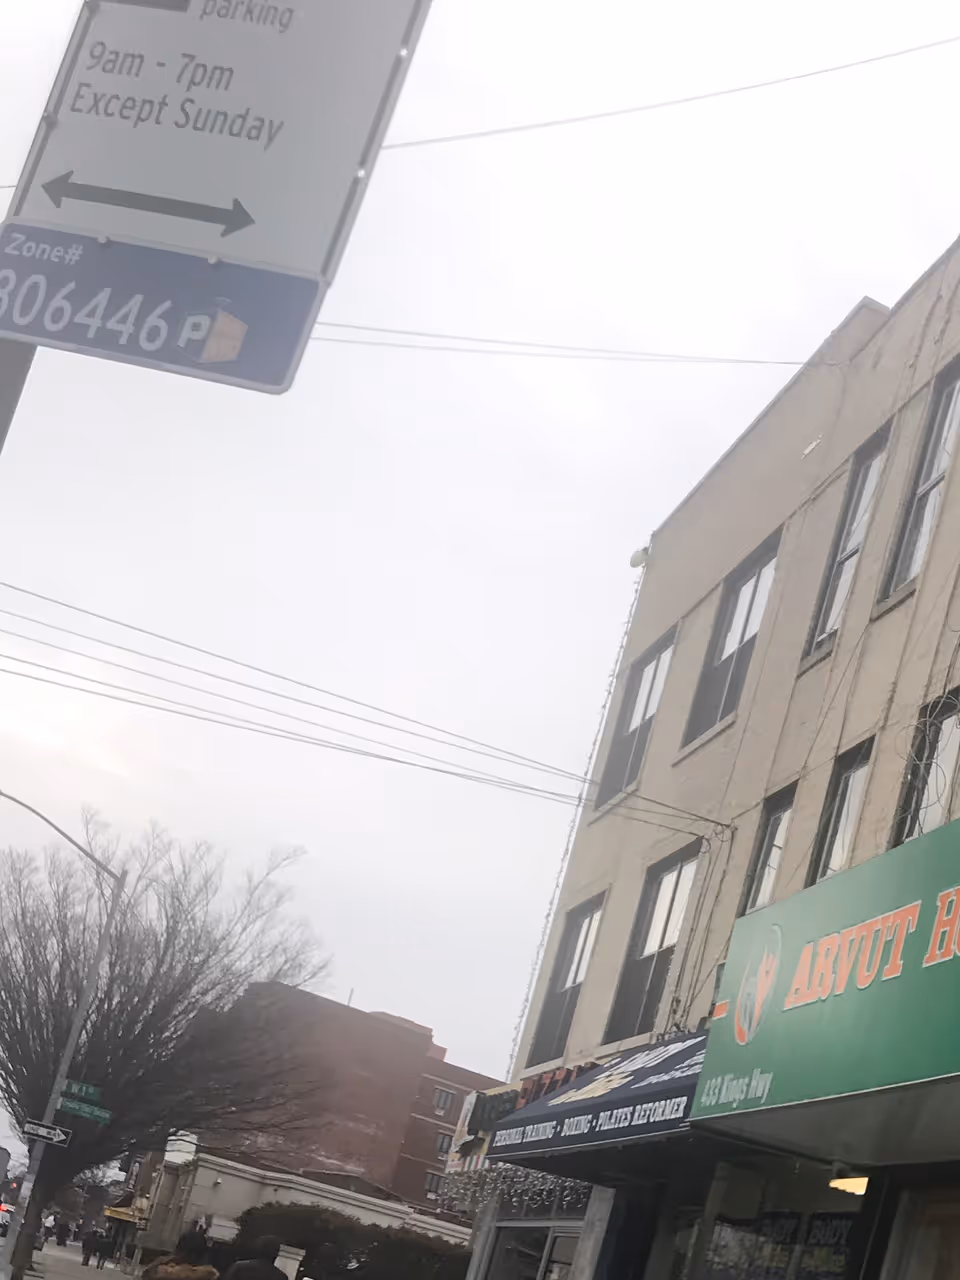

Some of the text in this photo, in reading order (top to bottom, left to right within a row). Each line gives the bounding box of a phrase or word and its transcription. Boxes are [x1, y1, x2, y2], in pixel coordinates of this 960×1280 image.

[199, 0, 294, 33] parking
[86, 41, 145, 78] 9am
[176, 53, 235, 92] 7pm
[70, 82, 285, 152] Except Sunday
[4, 232, 84, 265] Zone#
[783, 900, 922, 1011] ARVUT
[746, 1068, 774, 1105] Hwy
[522, 1120, 558, 1143] TRAINING
[560, 1114, 593, 1137] BOXING
[595, 1106, 634, 1131] PILATES
[632, 1096, 688, 1126] REFORMER
